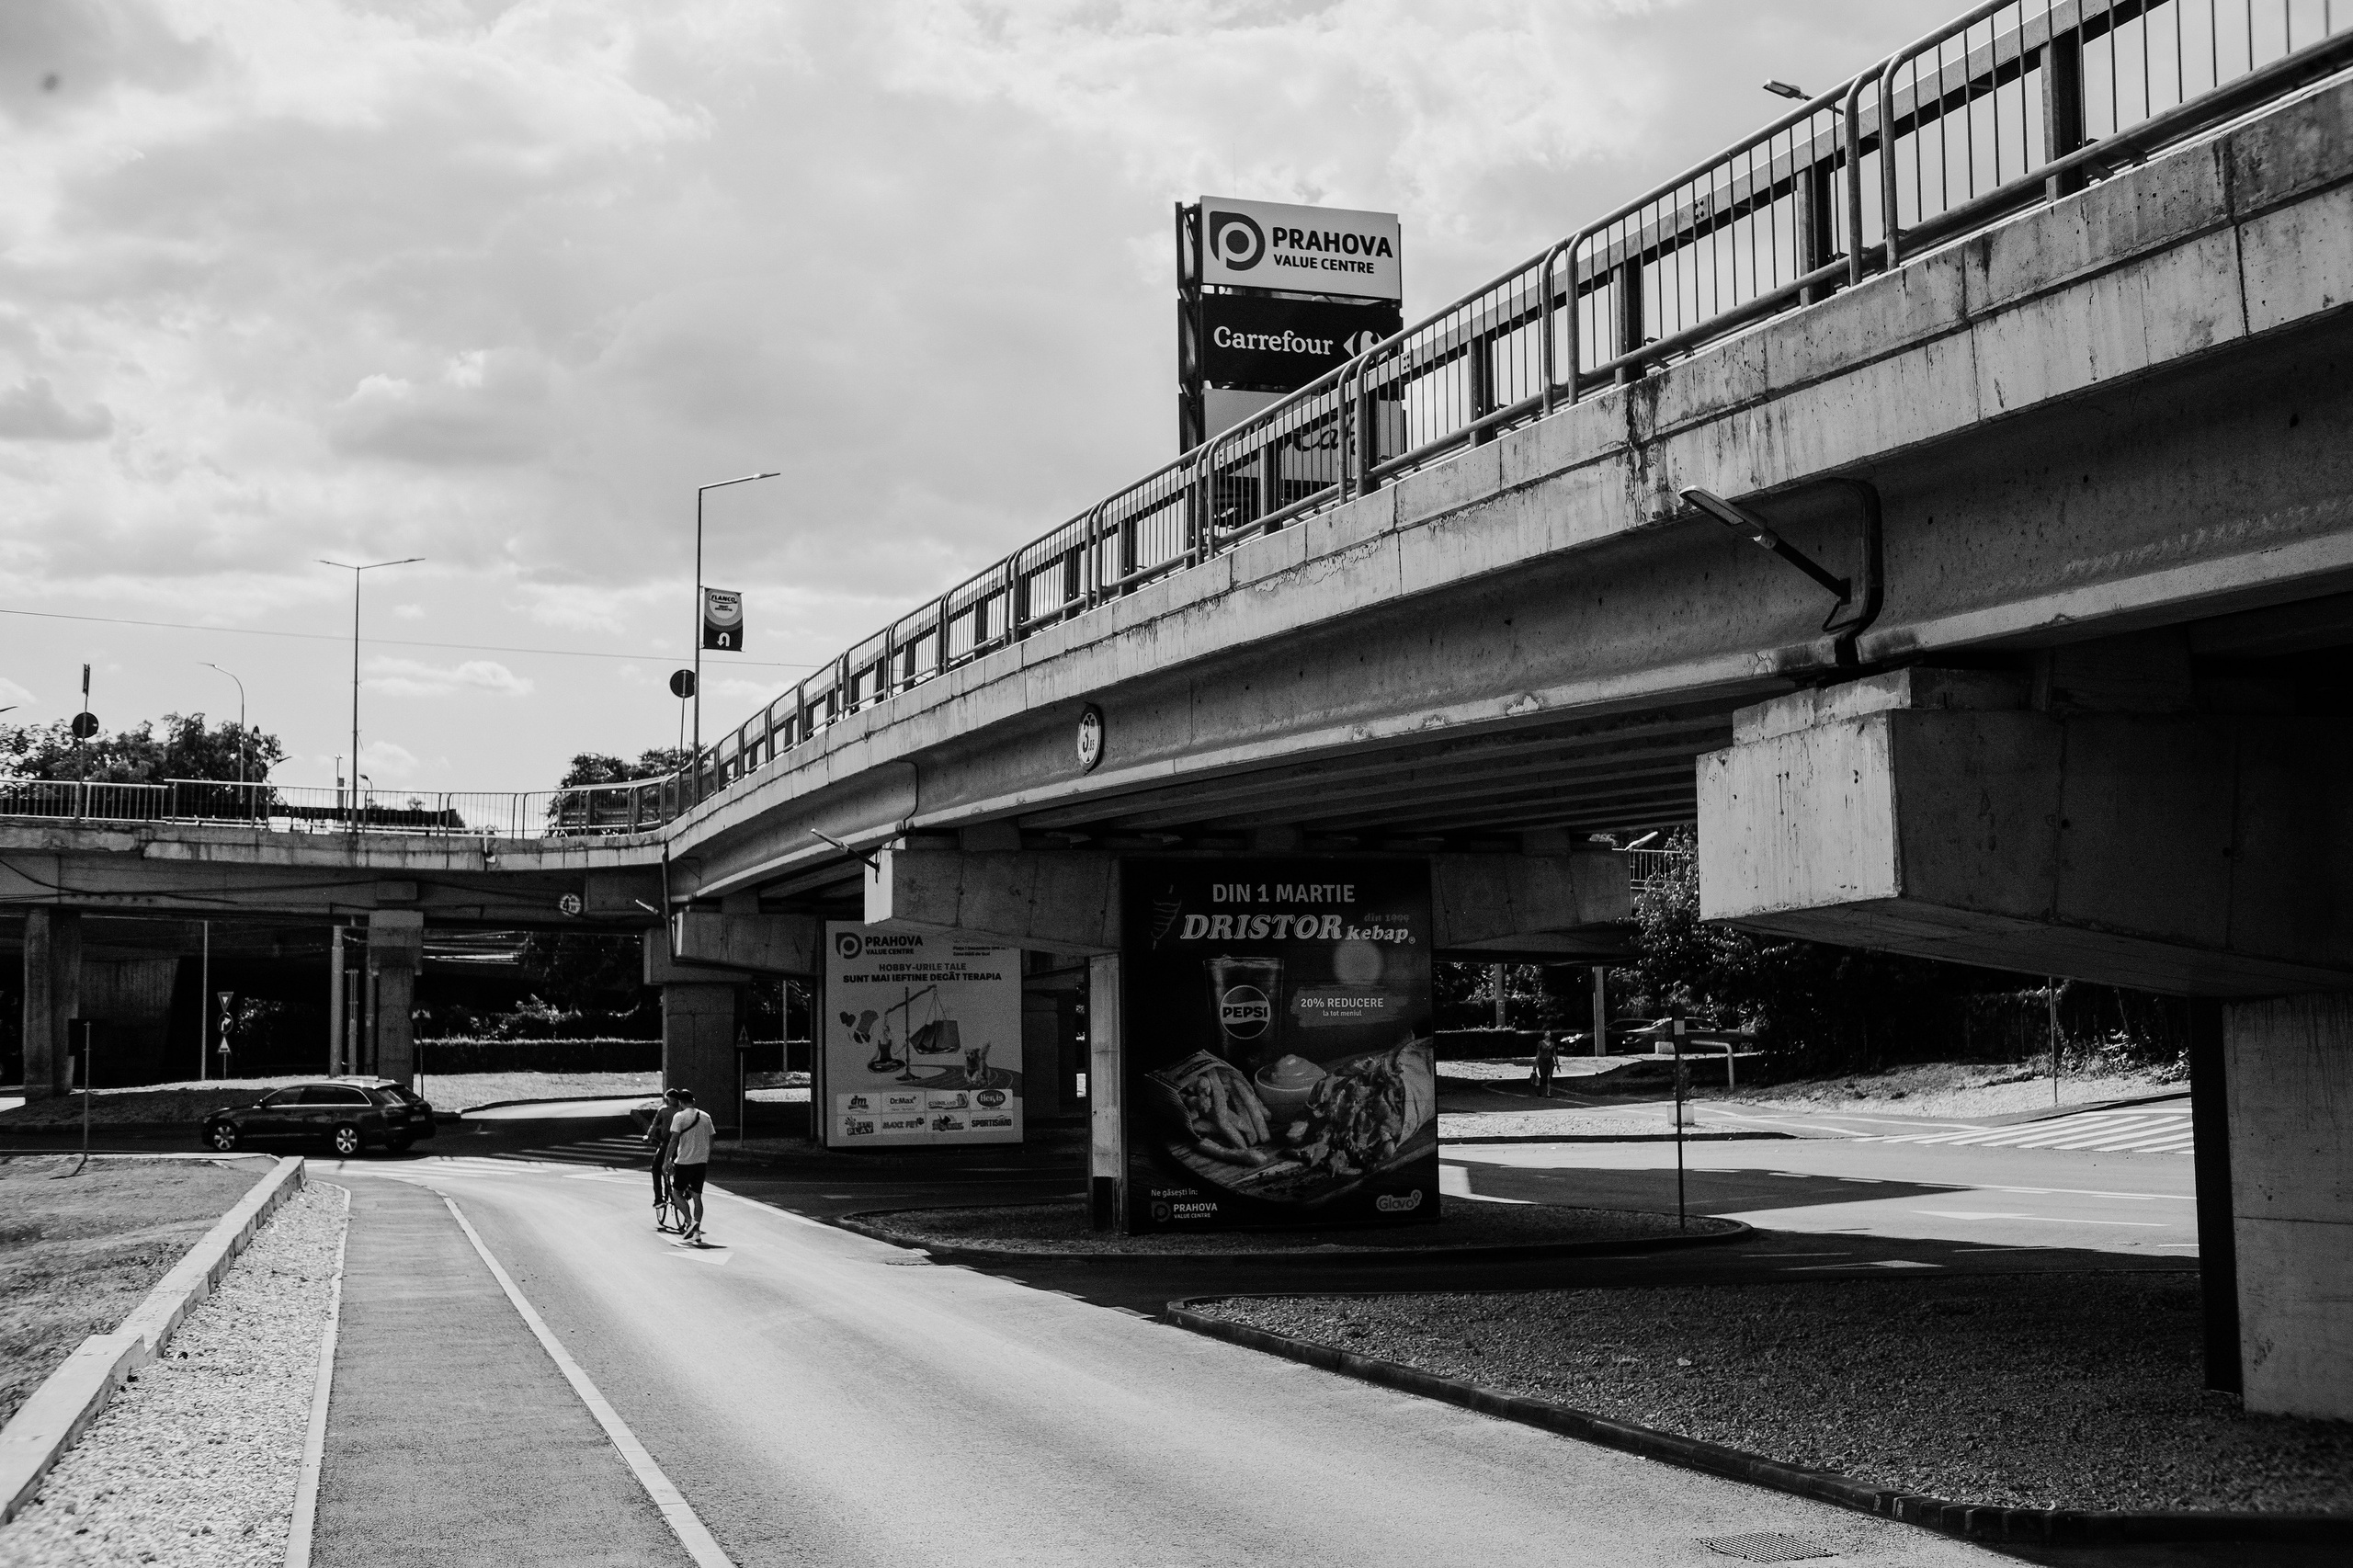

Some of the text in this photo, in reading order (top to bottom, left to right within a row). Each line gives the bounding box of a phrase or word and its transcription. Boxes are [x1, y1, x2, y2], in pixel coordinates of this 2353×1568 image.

[1272, 227, 1393, 258] PRAHOVA
[1273, 254, 1374, 274] VALUE CENTRE
[1213, 325, 1334, 355] Carrefour
[710, 594, 735, 602] FLANCO
[1212, 883, 1355, 903] DIN 1 MARTIE
[1179, 914, 1409, 943] DRISTOR kebap
[865, 936, 924, 947] PRAHOVA
[879, 962, 966, 971] HOBBY-URILE TALE
[843, 974, 870, 983] SUNT
[871, 974, 890, 983] MAI
[892, 973, 927, 983] IEFTINE
[962, 972, 1002, 981] TERAPIA
[1301, 997, 1384, 1008] 20% REDUCERE
[1222, 1006, 1267, 1018] PEPSI
[850, 1095, 867, 1106] dm
[1173, 1202, 1218, 1212] PRAHOVA
[1379, 1198, 1414, 1210] Glovo
